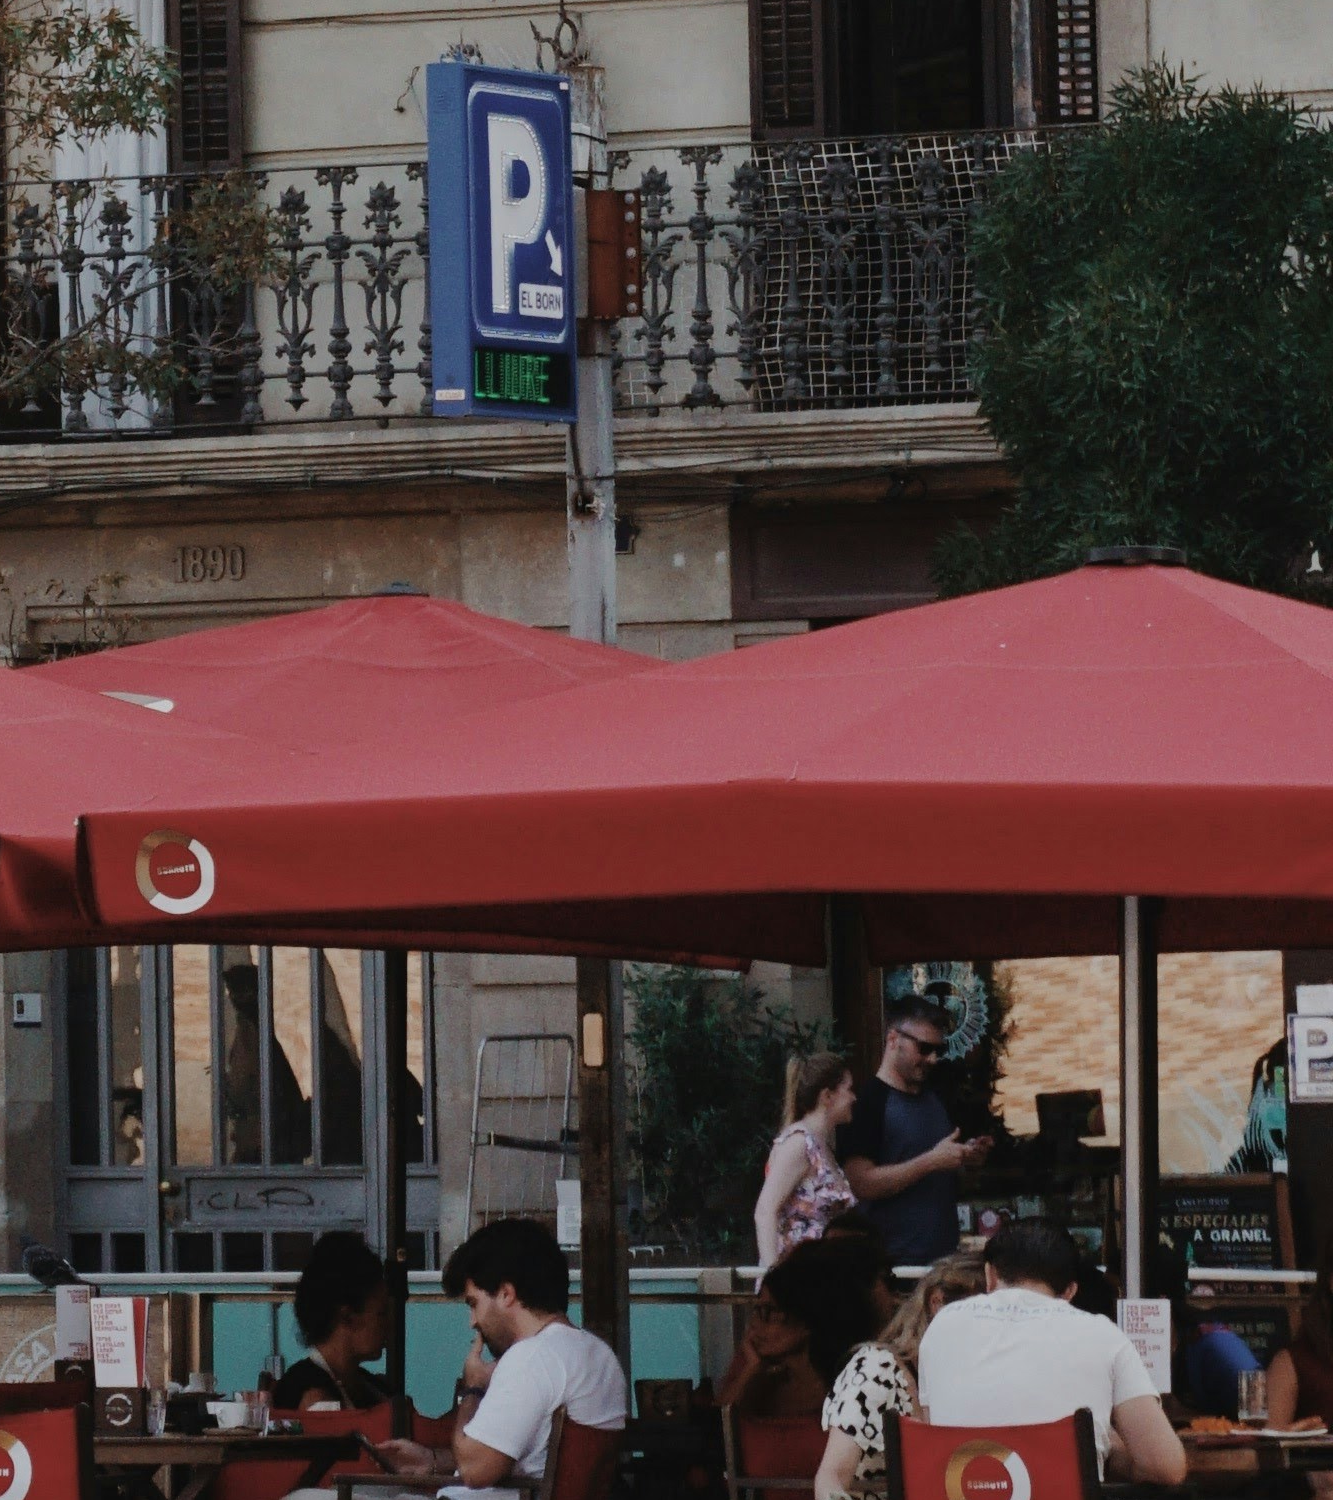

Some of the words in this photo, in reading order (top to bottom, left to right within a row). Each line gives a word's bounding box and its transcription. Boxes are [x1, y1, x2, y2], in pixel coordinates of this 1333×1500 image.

[487, 112, 545, 314] P
[521, 290, 533, 309] EL
[535, 292, 562, 312] BORN
[173, 544, 246, 583] 1890
[1173, 1213, 1271, 1230] ESPECIALES
[1194, 1229, 1203, 1241] A
[1210, 1229, 1272, 1243] GRANEL
